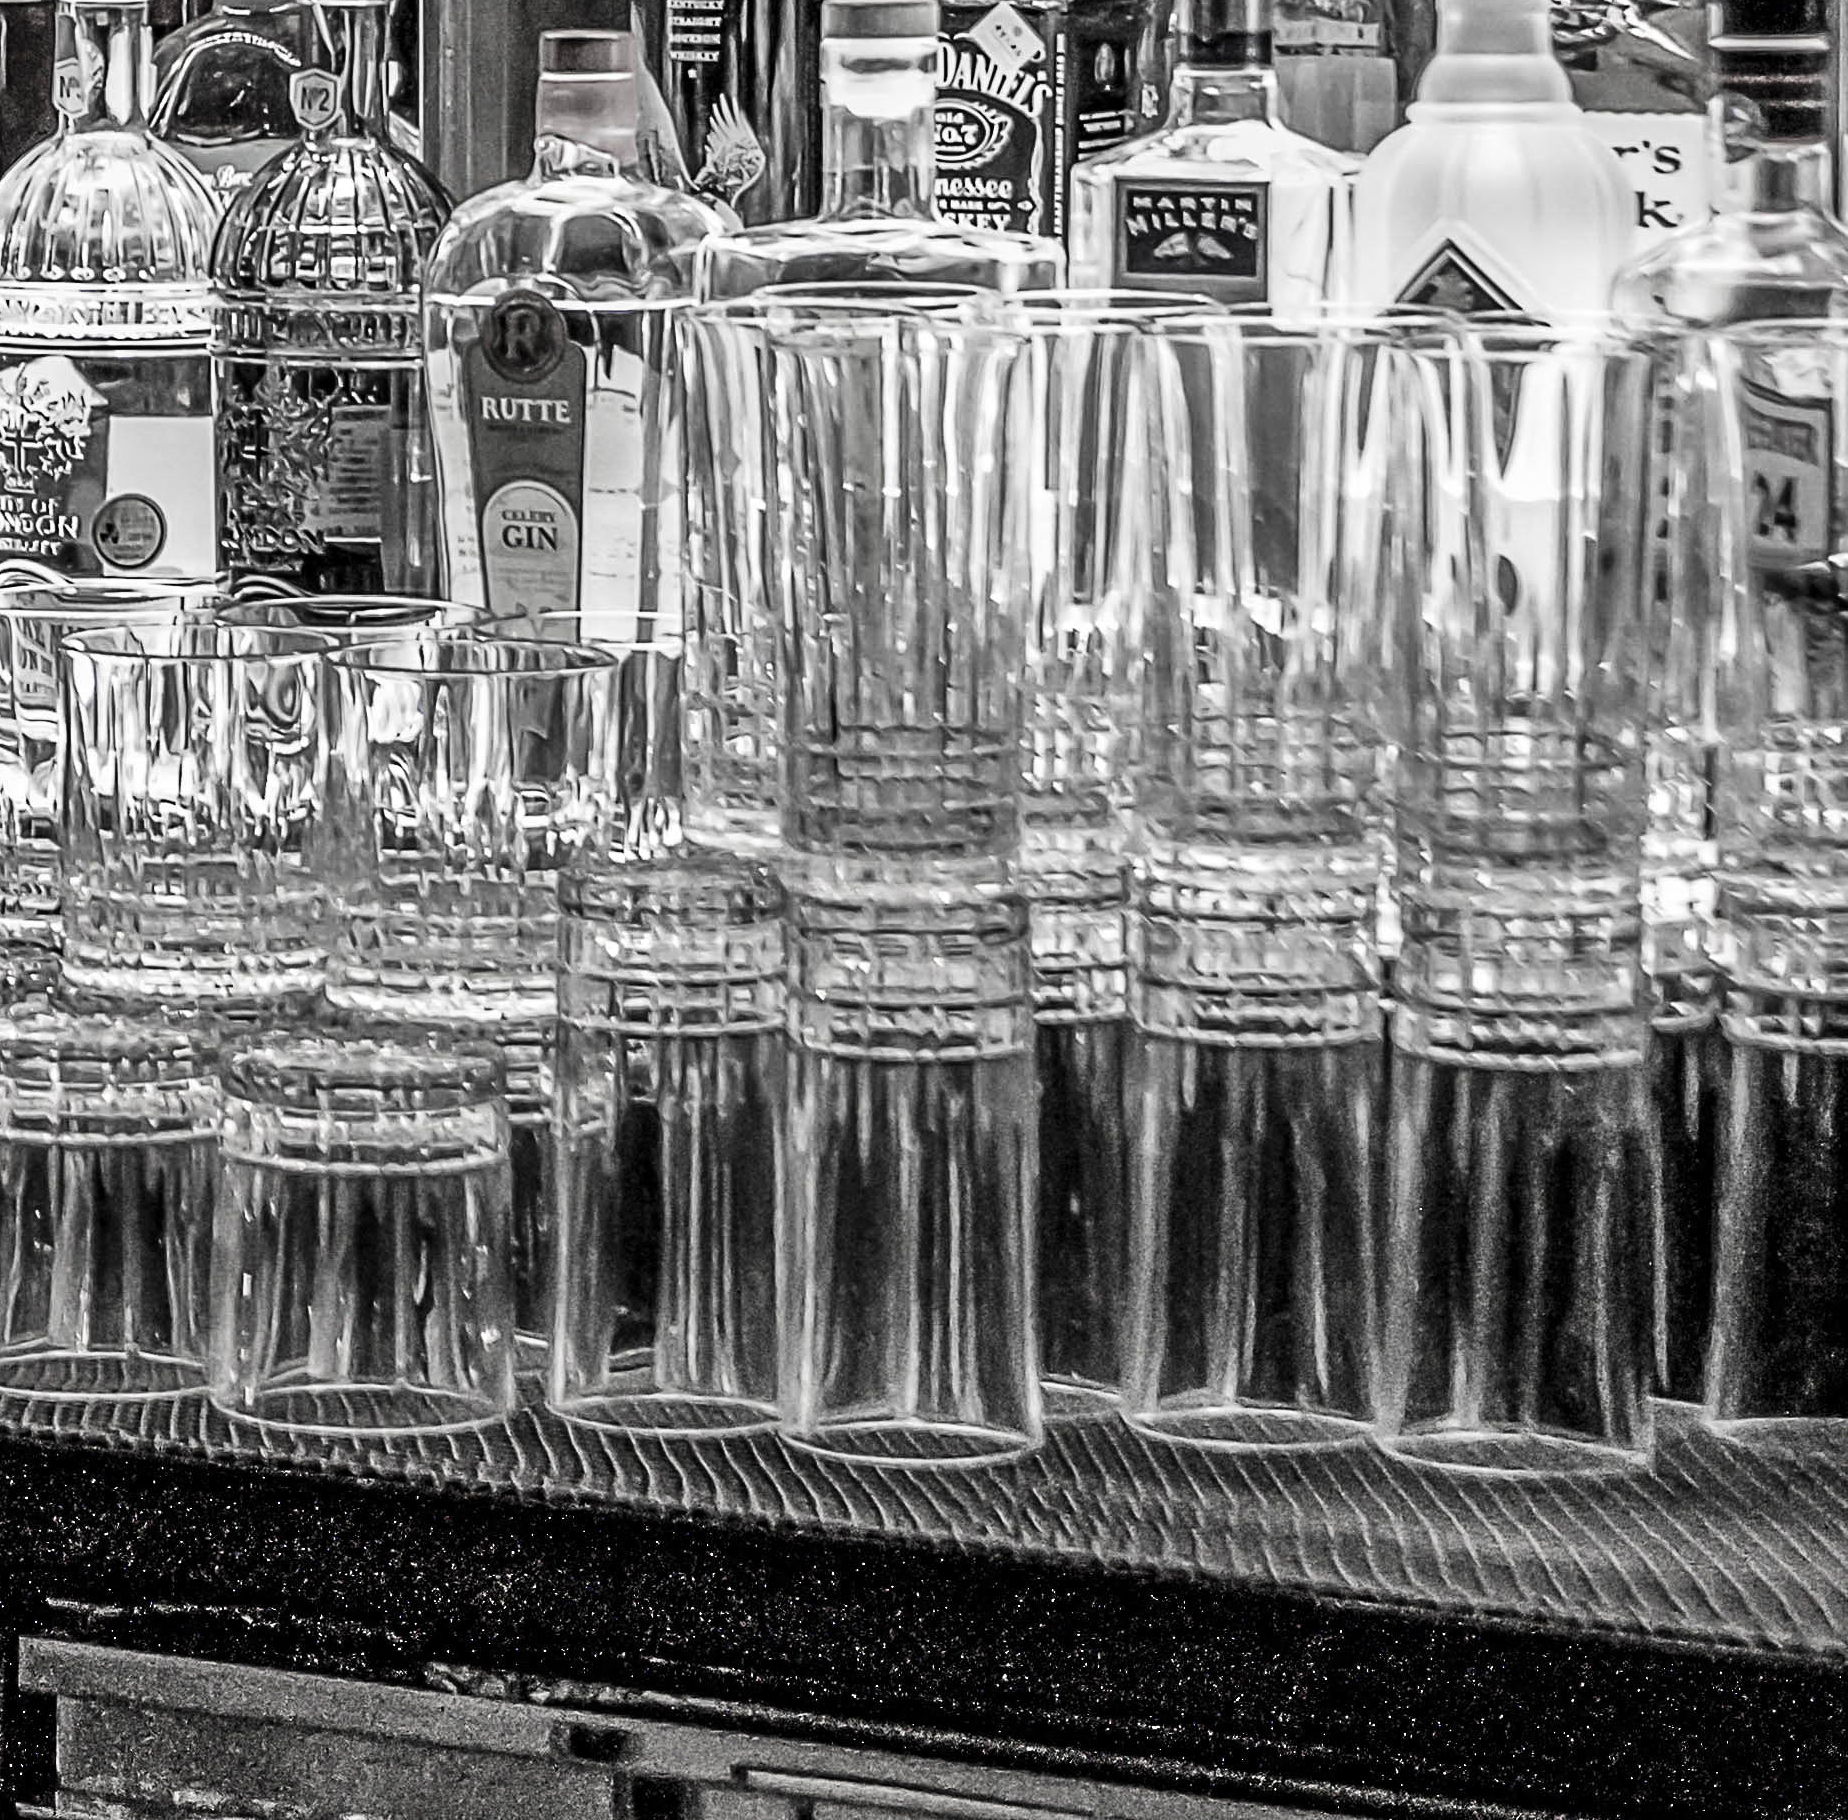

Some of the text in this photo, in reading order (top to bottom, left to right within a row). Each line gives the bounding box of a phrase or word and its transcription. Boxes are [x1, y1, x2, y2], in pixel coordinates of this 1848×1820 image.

[1132, 196, 1253, 213] MARTIN
[480, 396, 572, 424] RUTTE
[501, 526, 558, 551] GIN
